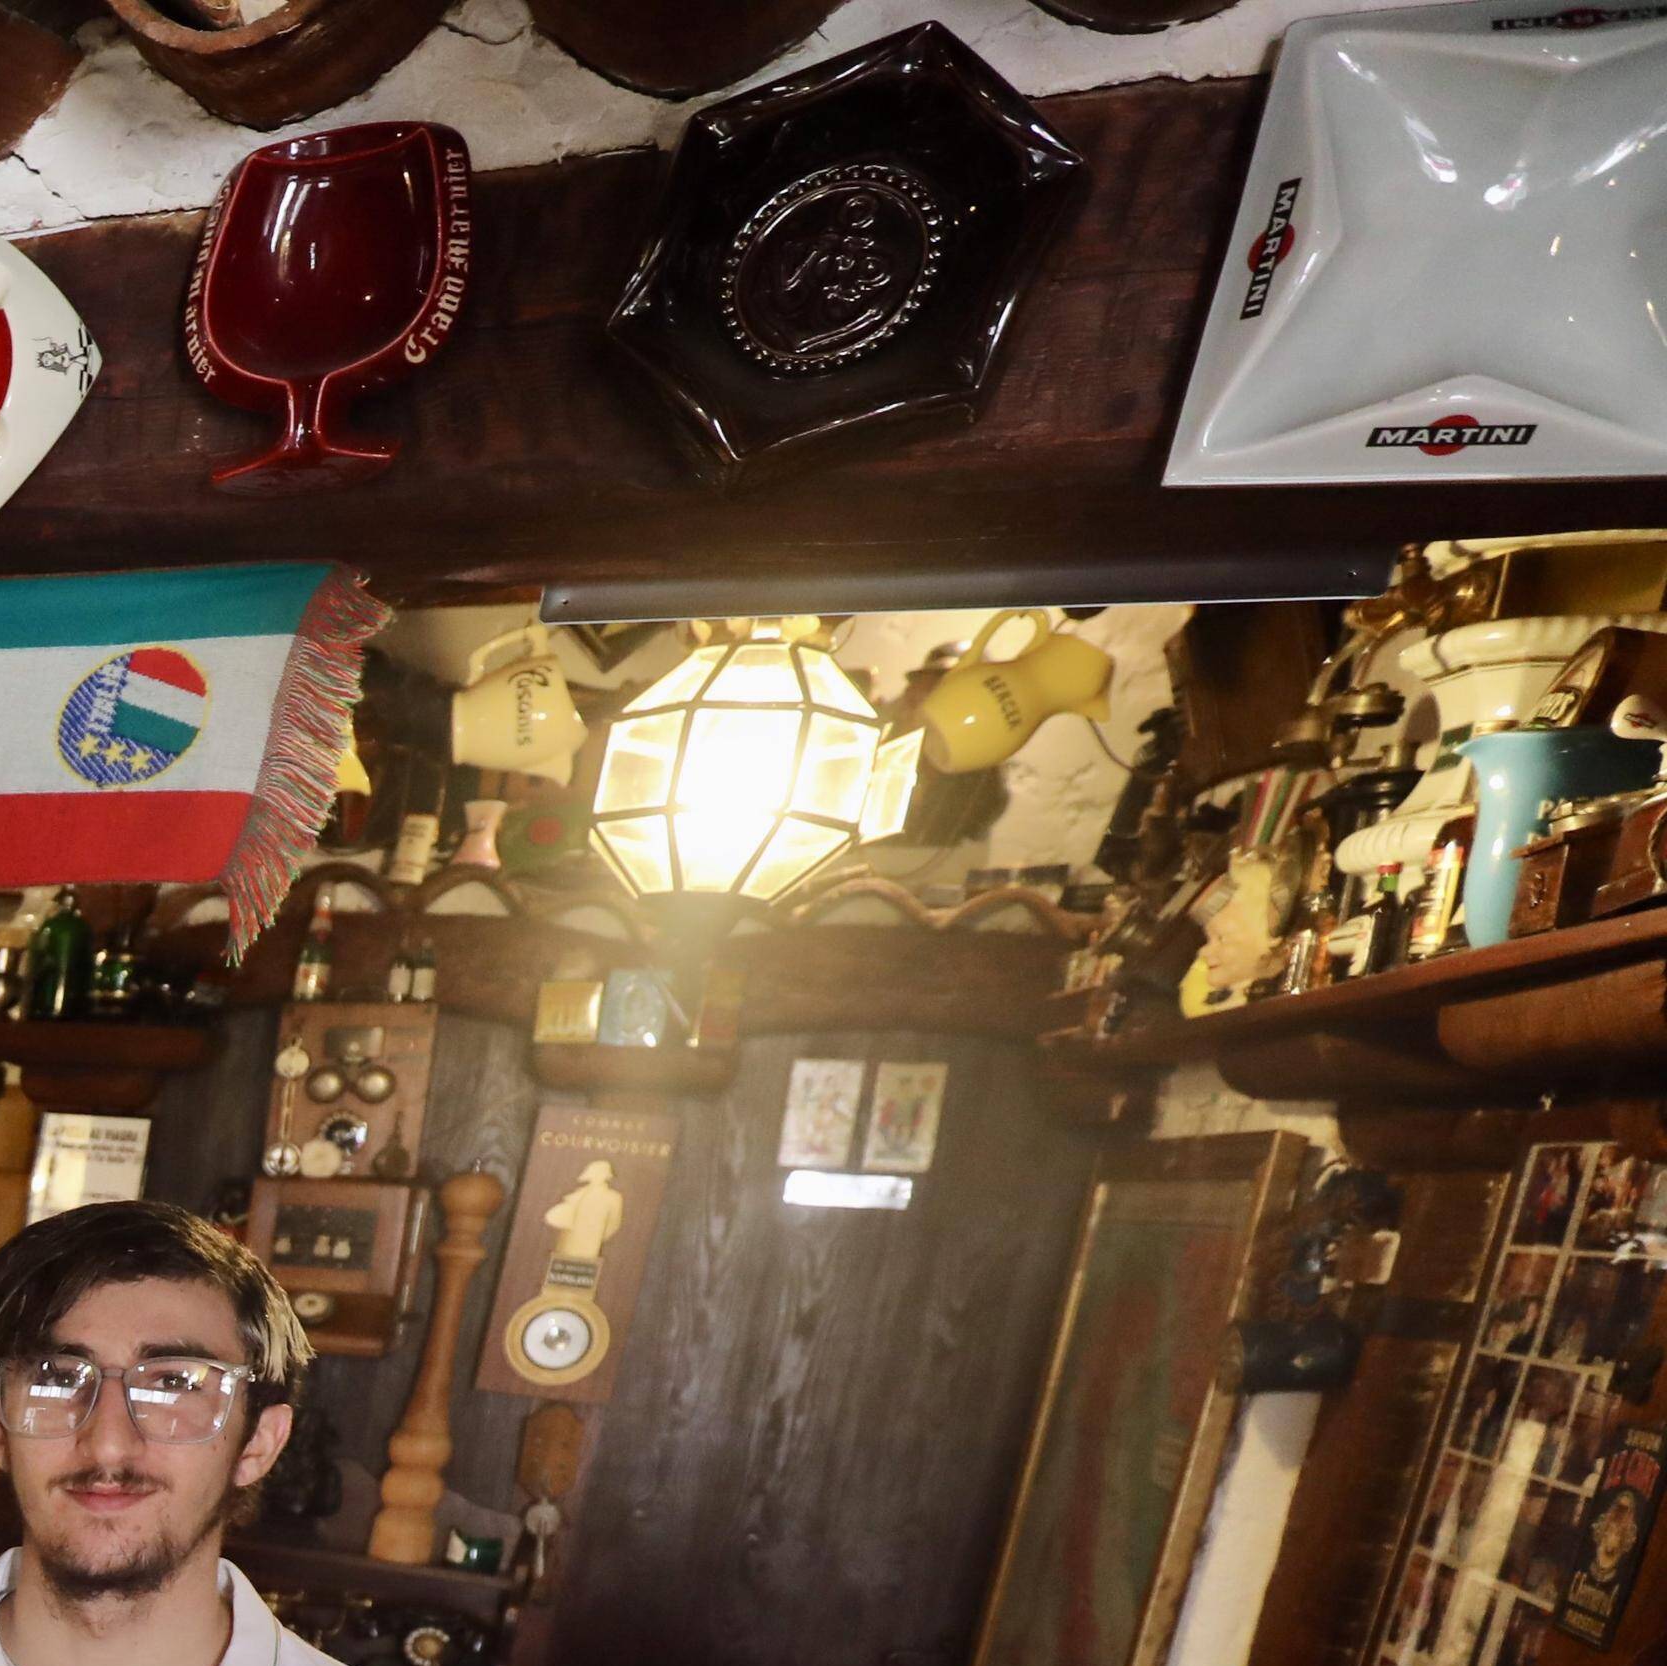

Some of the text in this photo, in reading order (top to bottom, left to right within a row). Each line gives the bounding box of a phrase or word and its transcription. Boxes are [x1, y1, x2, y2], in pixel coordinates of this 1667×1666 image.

[1243, 184, 1297, 315] MARTINI
[1374, 426, 1528, 445] MARTINI
[982, 675, 1022, 731] BERGER
[538, 1131, 671, 1157] COURVOISIER
